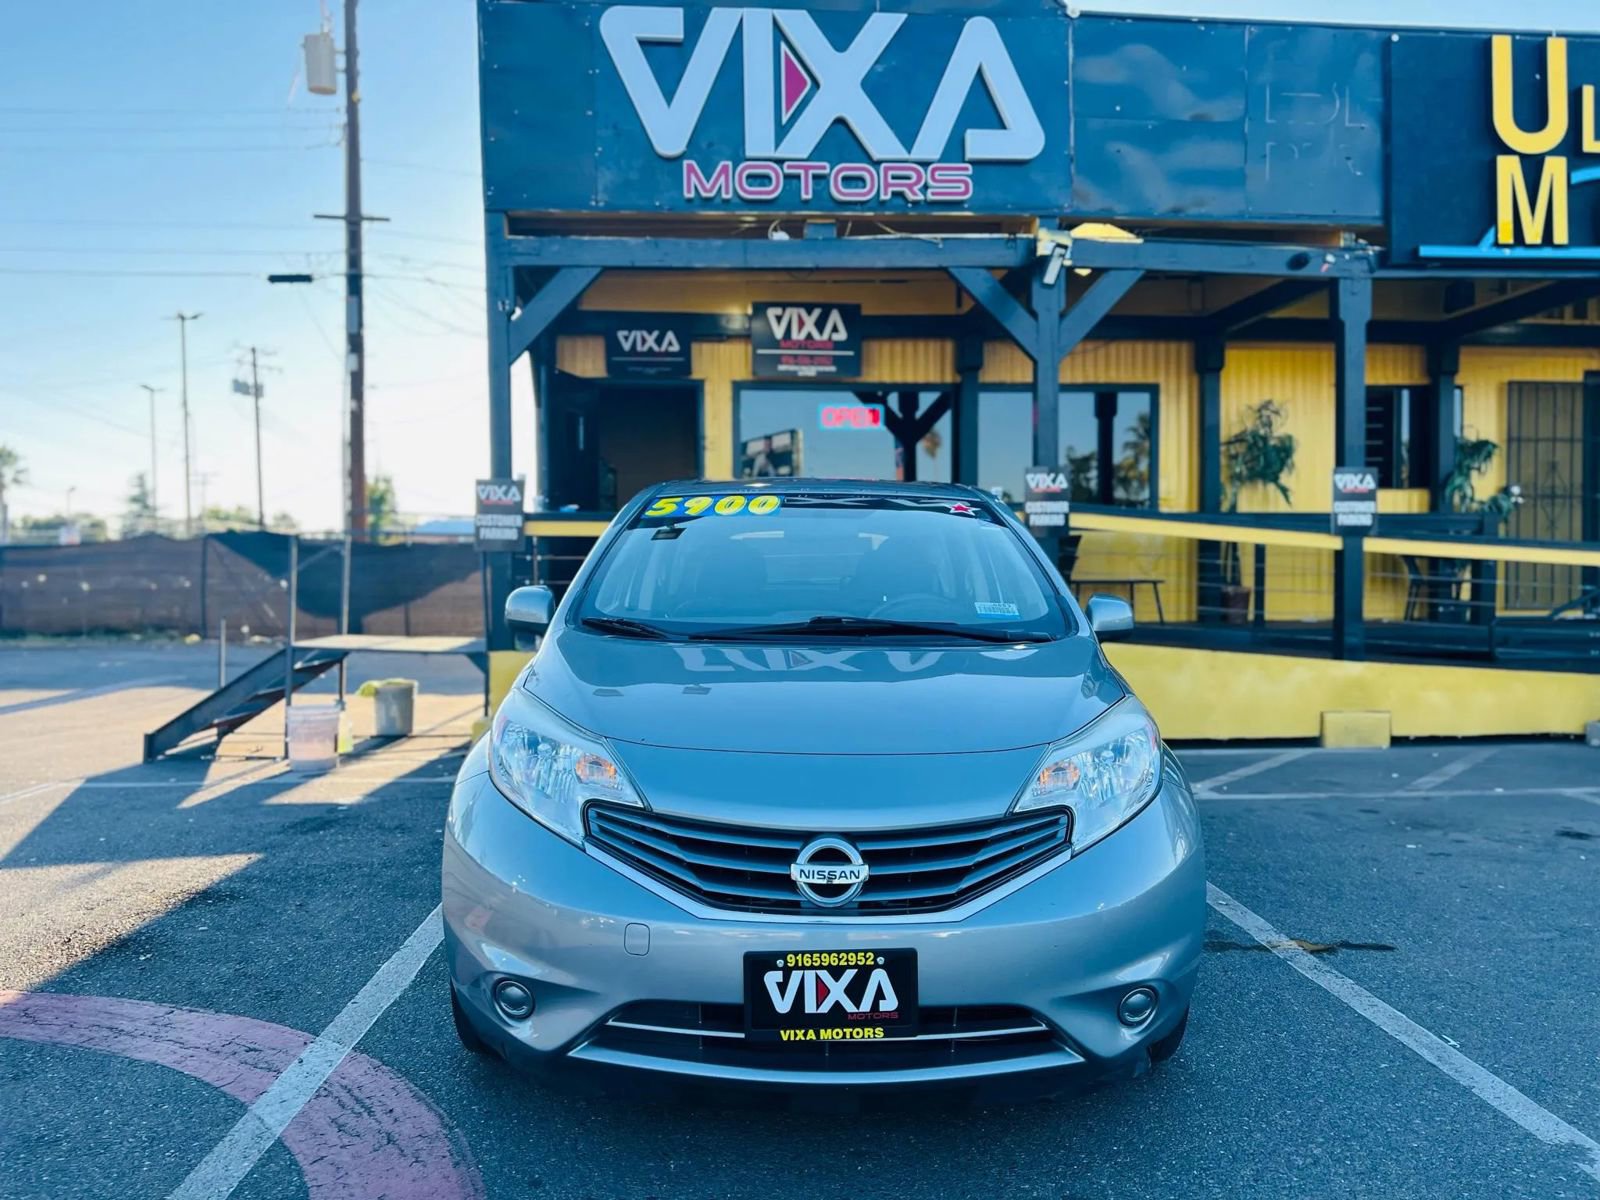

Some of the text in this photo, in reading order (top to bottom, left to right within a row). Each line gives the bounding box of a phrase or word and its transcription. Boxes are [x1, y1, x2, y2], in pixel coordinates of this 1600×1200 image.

[599, 5, 1046, 162] VIXA
[683, 159, 973, 202] MOTORS
[766, 307, 848, 341] VIXA
[617, 330, 681, 352] VIXA
[1026, 472, 1068, 489] VIXA
[1334, 472, 1377, 490] VIXA
[478, 484, 521, 501] VIXA
[645, 494, 782, 518] 5900
[799, 868, 860, 880] NISSAN
[786, 952, 875, 967] 9165962952
[763, 968, 899, 1014] VIXA
[847, 1011, 899, 1020] MOTORS
[780, 1027, 885, 1041] VIXA MOTORS
